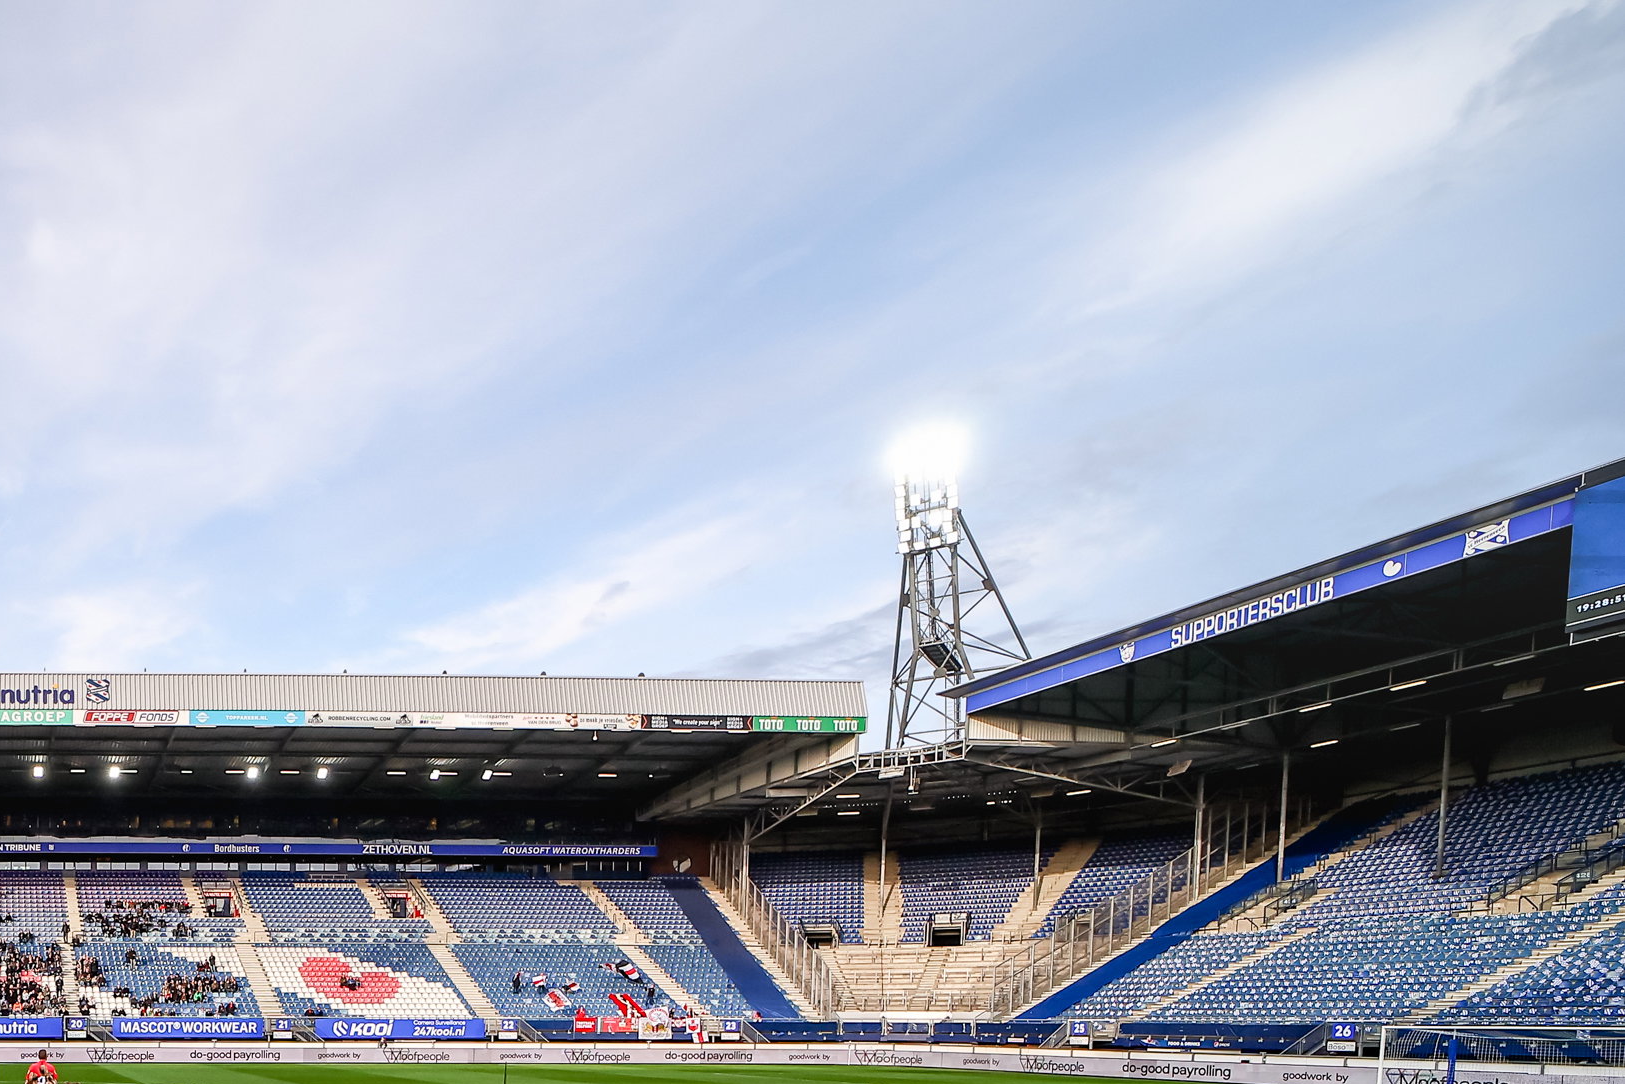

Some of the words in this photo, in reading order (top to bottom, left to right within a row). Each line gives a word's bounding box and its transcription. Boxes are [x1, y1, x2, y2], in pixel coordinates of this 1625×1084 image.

[1170, 577, 1335, 649] SUPPORTERSCLUB
[91, 712, 130, 722] FOPPE
[138, 712, 174, 722] FONDS
[759, 719, 784, 731] TOTO
[796, 719, 821, 731] TOTO
[833, 720, 858, 731] TOTO
[214, 844, 260, 853] Bordbusters
[362, 844, 433, 854] ZETHOVEN.NL
[502, 846, 551, 855] AQUASOFT
[552, 847, 641, 855] WATERONTHARDERS
[71, 1020, 82, 1028] 20
[182, 1022, 257, 1033] WORKWEAR
[278, 1020, 288, 1029] 21
[503, 1020, 514, 1029] 22
[726, 1021, 736, 1030] 23
[1074, 1023, 1085, 1033] 25
[413, 1026, 466, 1036] 247kooi.nl
[1334, 1025, 1351, 1036] 26
[20, 1051, 54, 1059] goodrk
[56, 1051, 65, 1060] by
[94, 1051, 155, 1063] Moofpeople
[190, 1050, 232, 1061] do-good
[234, 1050, 281, 1061] payrolling
[317, 1052, 350, 1060] goodwork
[353, 1052, 361, 1060] by
[391, 1051, 450, 1063] Moofpeople
[499, 1052, 532, 1060] goodwork
[534, 1052, 543, 1060] by
[572, 1051, 631, 1063] Moofpeople
[664, 1051, 706, 1061] do-good
[707, 1051, 752, 1062] payrolling
[788, 1053, 820, 1061] goodwork
[823, 1053, 831, 1061] by
[864, 1052, 923, 1065] Moofpeople
[963, 1057, 991, 1065] goodwork
[992, 1057, 1000, 1066] by
[1026, 1057, 1085, 1074] Moofpeople
[1122, 1062, 1170, 1076] do-good
[1171, 1065, 1231, 1080] payrolling
[1282, 1072, 1332, 1082] goodwork
[1336, 1073, 1349, 1084] by
